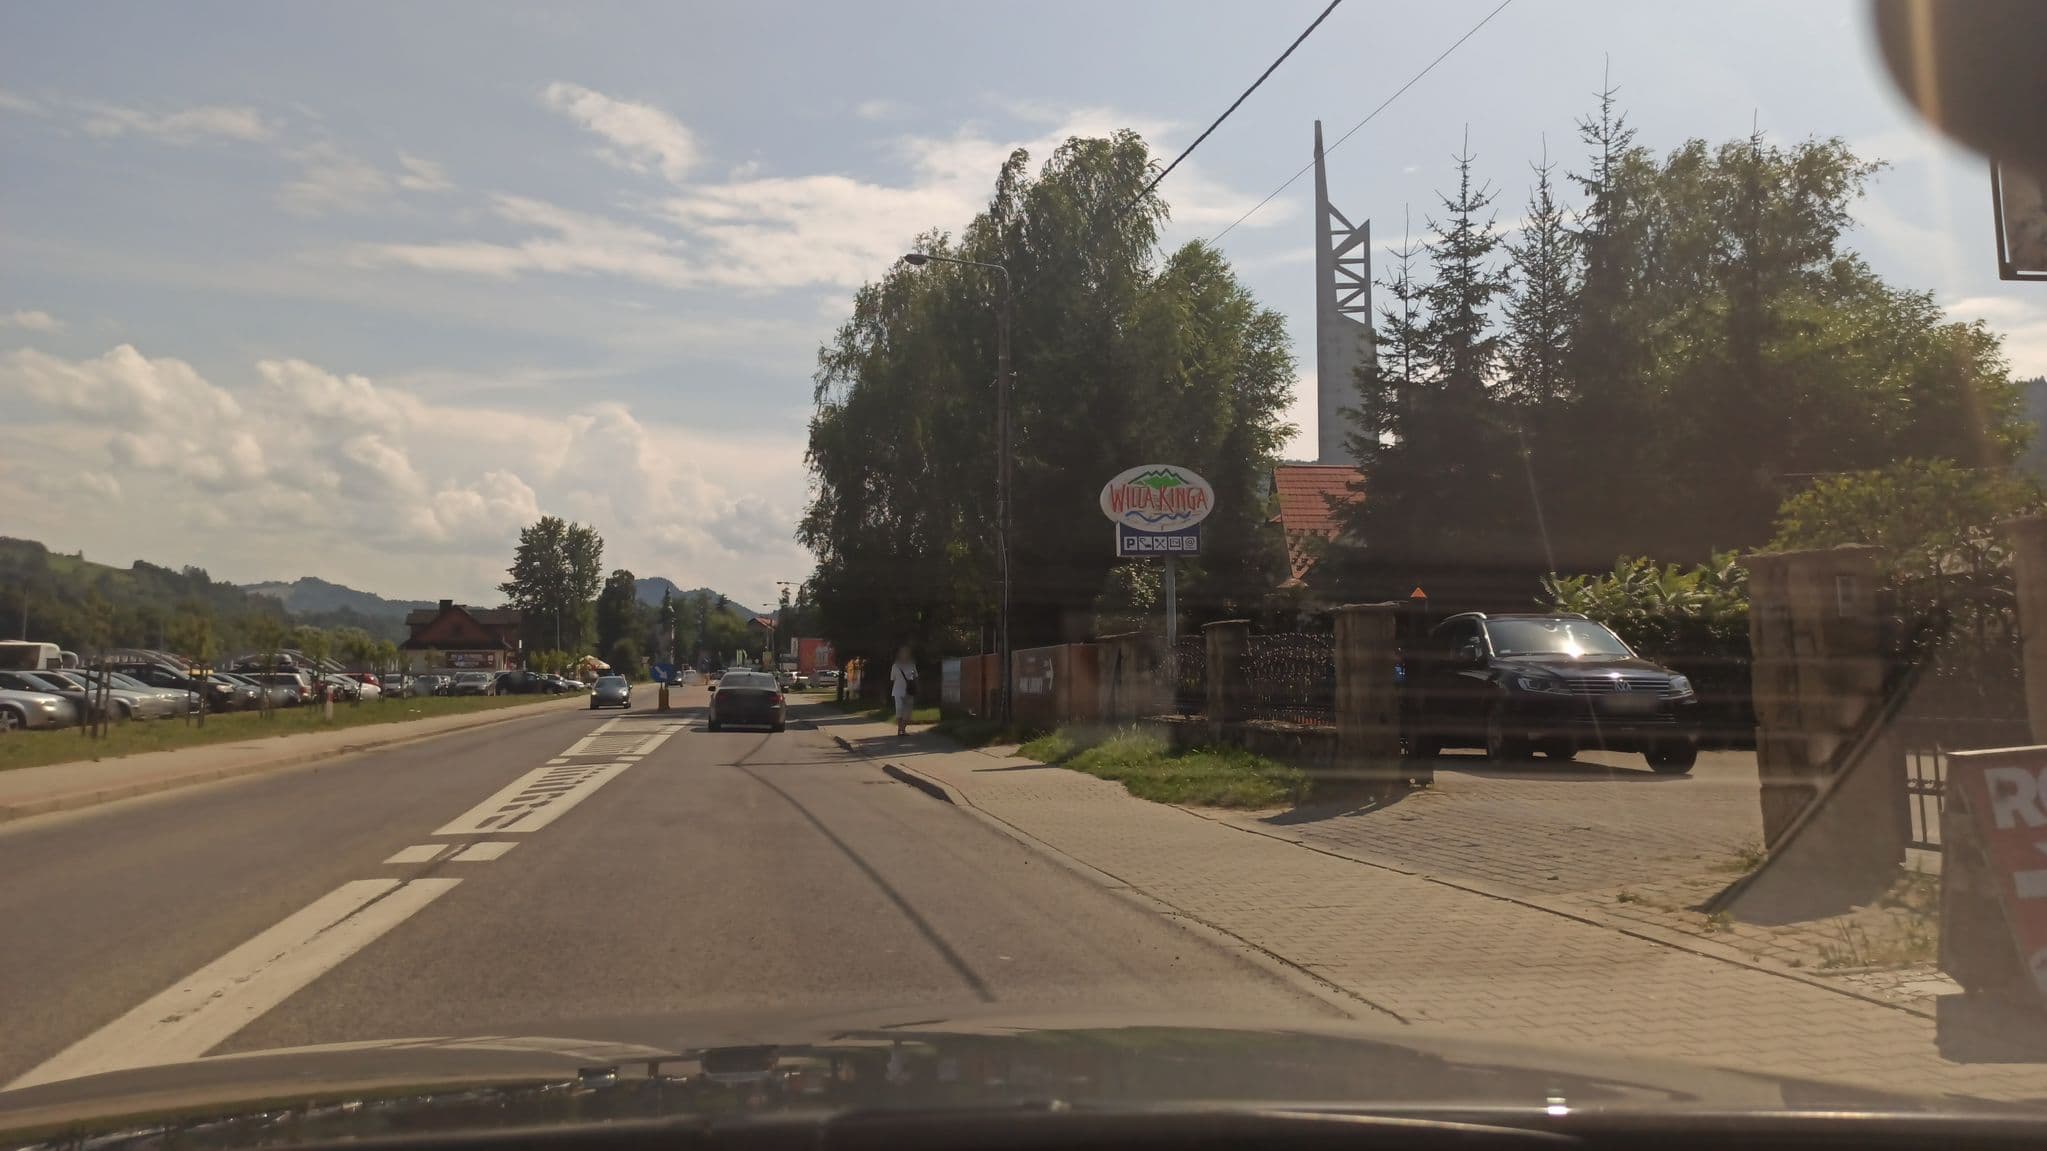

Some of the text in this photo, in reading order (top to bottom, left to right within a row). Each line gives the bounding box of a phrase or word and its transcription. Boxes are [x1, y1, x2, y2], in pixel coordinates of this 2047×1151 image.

[1110, 483, 1208, 513] WILLA KINGA
[1127, 538, 1135, 548] P
[1984, 766, 2047, 829] R
